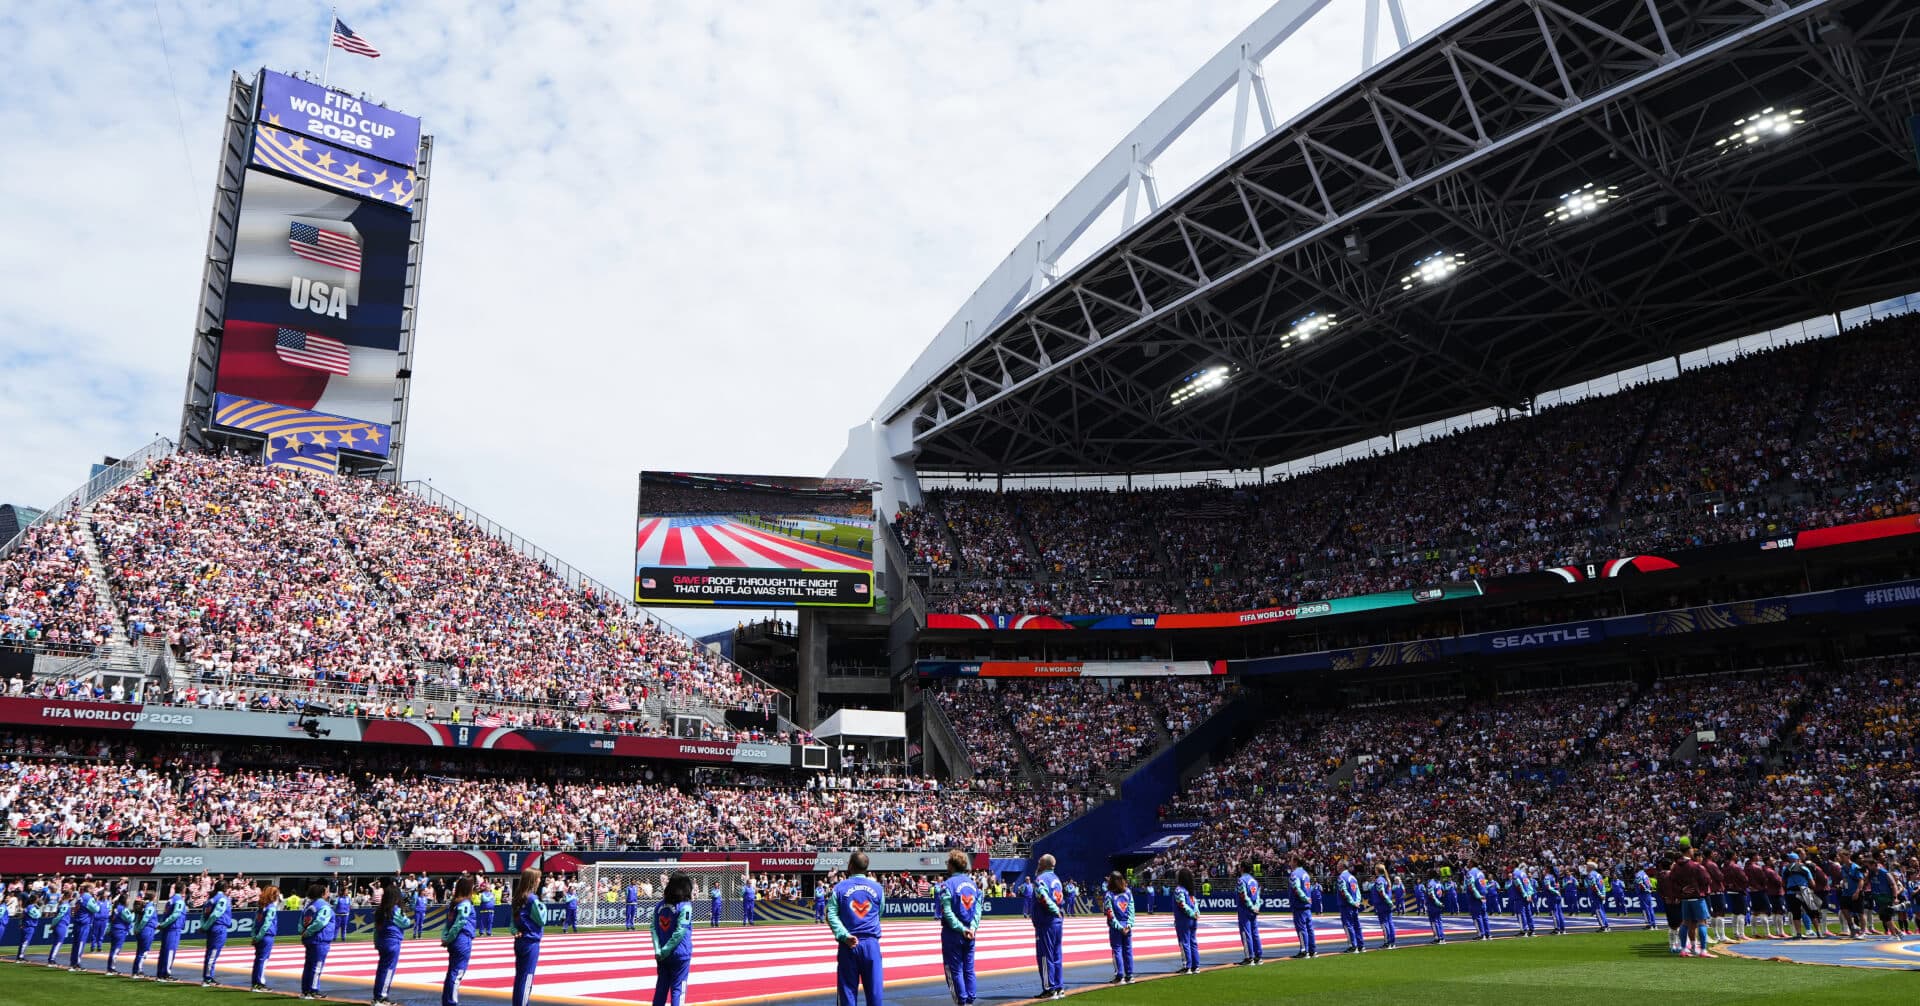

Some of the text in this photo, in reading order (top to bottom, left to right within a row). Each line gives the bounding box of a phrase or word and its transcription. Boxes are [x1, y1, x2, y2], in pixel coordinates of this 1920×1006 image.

[324, 91, 364, 116] FIFA
[290, 96, 396, 139] WORLD CUP
[307, 119, 373, 149] 2026
[290, 276, 347, 320] USA
[1777, 538, 1794, 548] USA
[673, 576, 838, 588] GAVE PROOF THROUGH THE NIGHT
[674, 585, 837, 596] THAT OUR FLAG WAS STILL THERE
[1240, 604, 1329, 622] FIFA WORLD CUP 2026
[1492, 627, 1591, 648] SEATTLE
[42, 707, 193, 724] FIFA WORLD CUP 2026
[603, 741, 615, 749] USA
[679, 745, 767, 757] FIFA WORLD CUP 2026
[65, 856, 203, 866] FIFA WORLD CUP 2026
[340, 856, 353, 865] USA
[820, 858, 844, 866] 2026
[885, 903, 902, 913] IFA
[1208, 899, 1237, 908] WORL
[1265, 898, 1291, 908] 202
[548, 908, 566, 921] IFA
